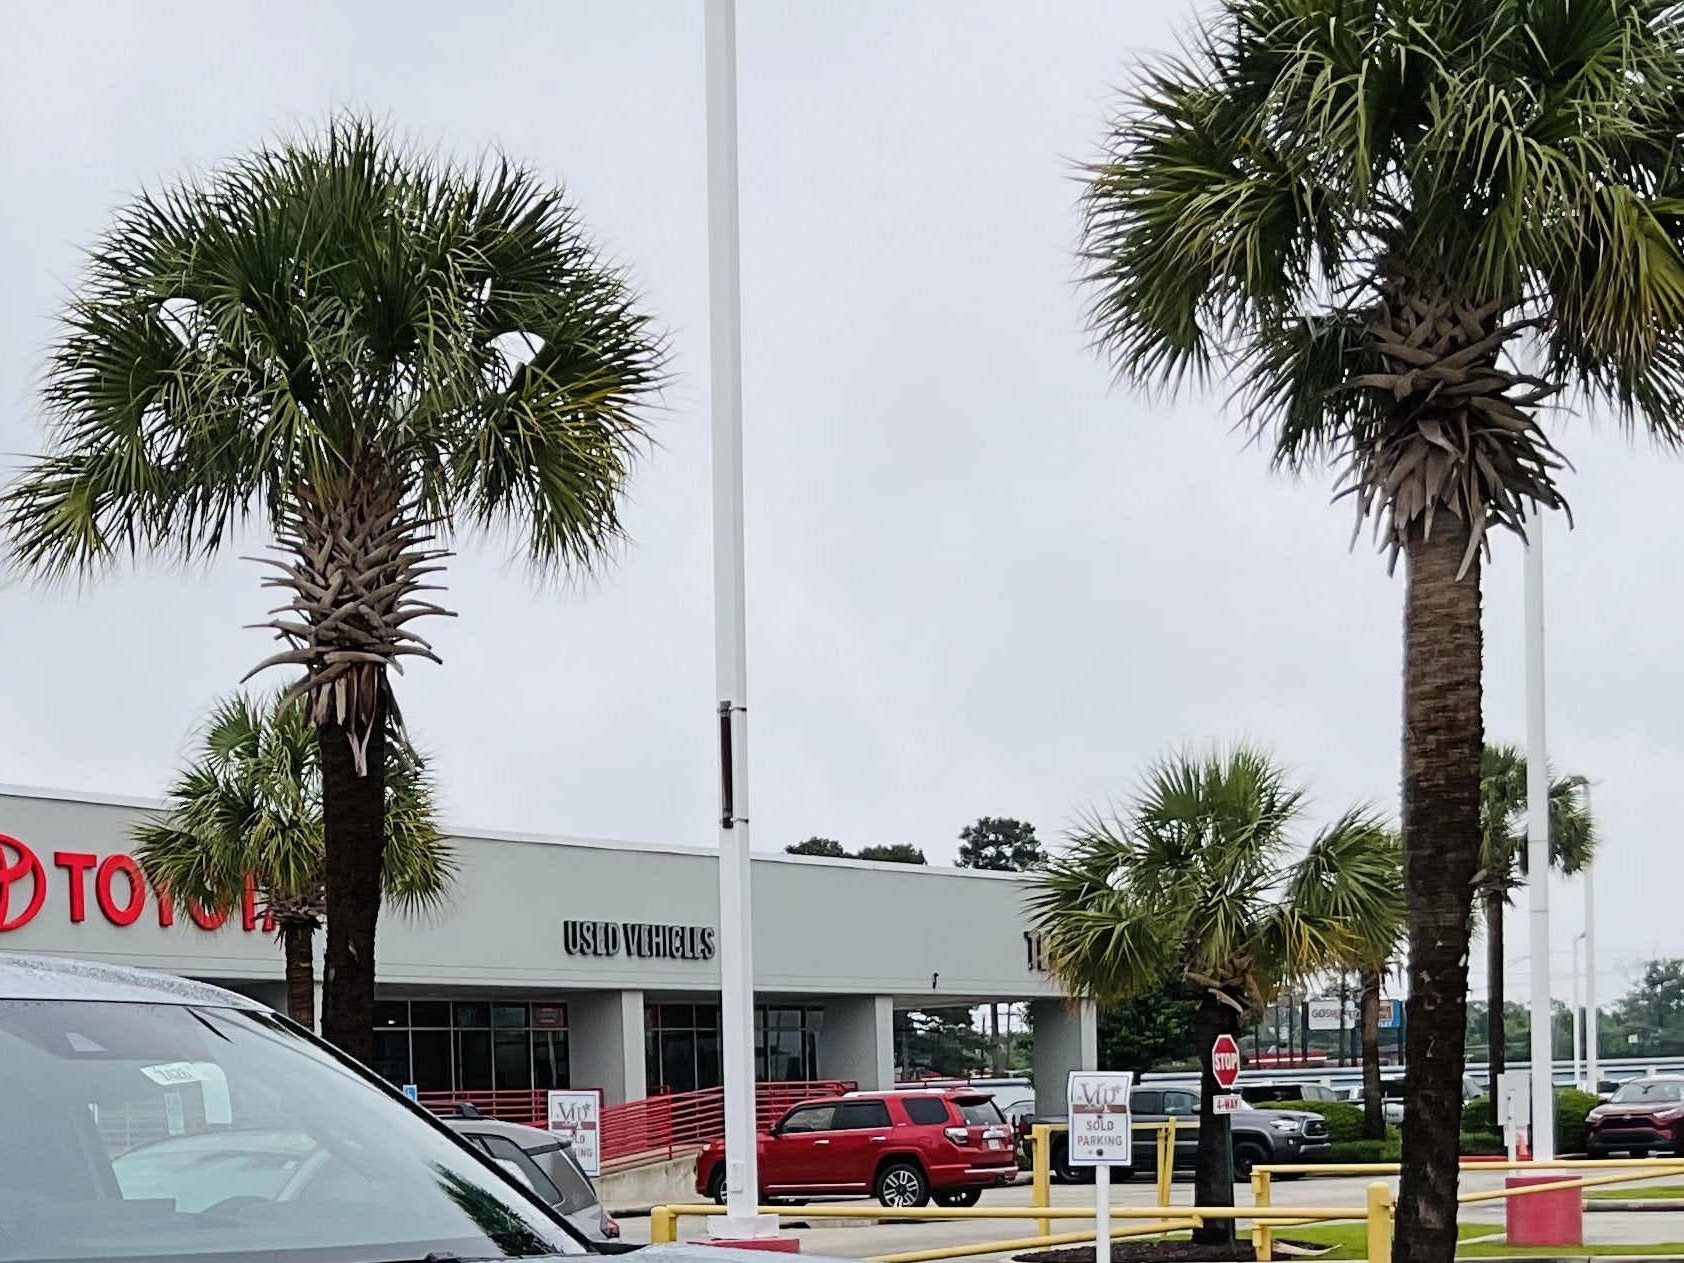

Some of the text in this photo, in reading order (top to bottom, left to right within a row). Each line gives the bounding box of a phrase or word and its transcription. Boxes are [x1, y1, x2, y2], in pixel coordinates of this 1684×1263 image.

[54, 851, 277, 932] TOYT
[563, 920, 715, 960] USED VEHICLES
[1215, 1053, 1236, 1071] STOP
[1217, 1098, 1238, 1110] 4-WAY
[1086, 1121, 1114, 1131] SOLD
[1077, 1136, 1123, 1146] PARKING
